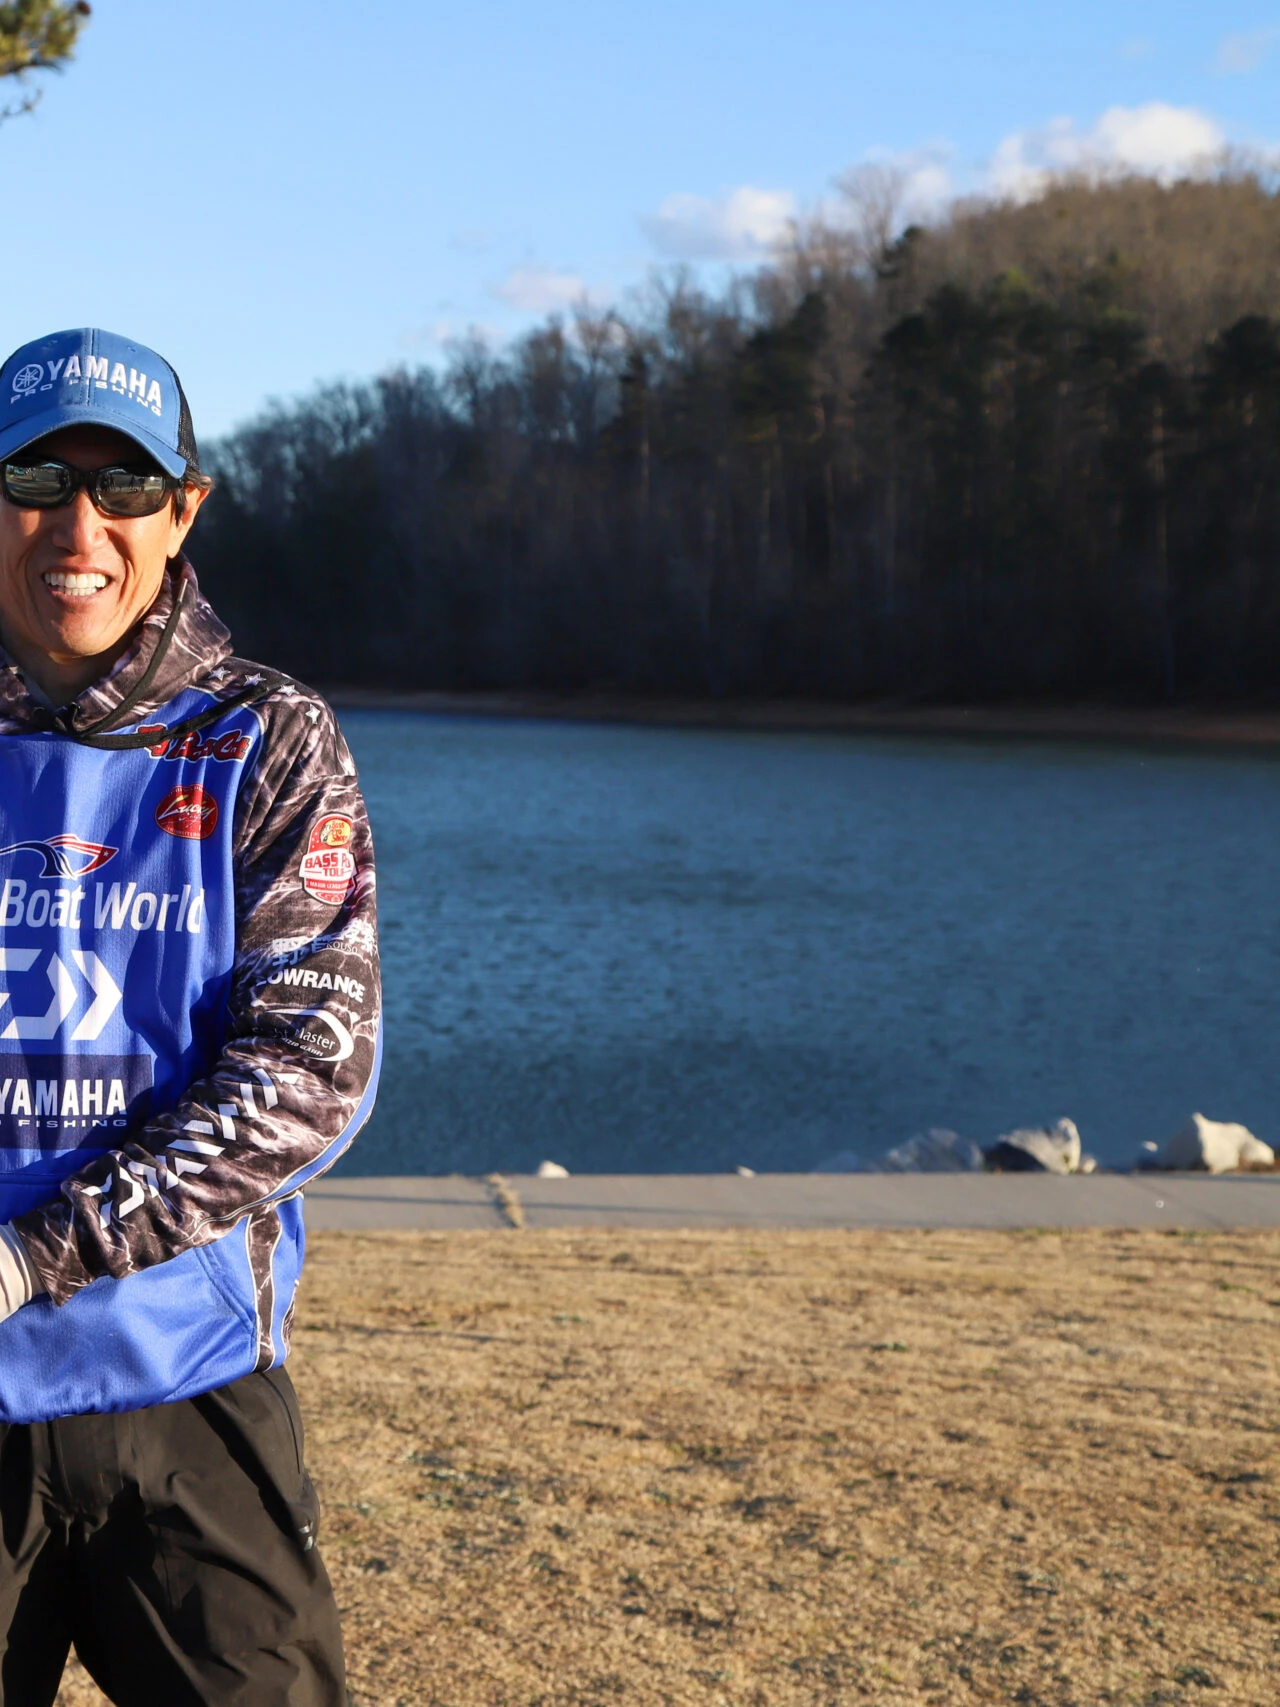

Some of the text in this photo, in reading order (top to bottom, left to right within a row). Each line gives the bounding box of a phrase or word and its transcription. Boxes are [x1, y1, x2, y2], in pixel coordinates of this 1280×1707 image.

[10, 379, 162, 417] PRO FISHING
[47, 354, 162, 409] YAMAHA
[305, 853, 338, 869] BASS
[94, 881, 206, 934] World
[18, 1119, 128, 1129] FISHING
